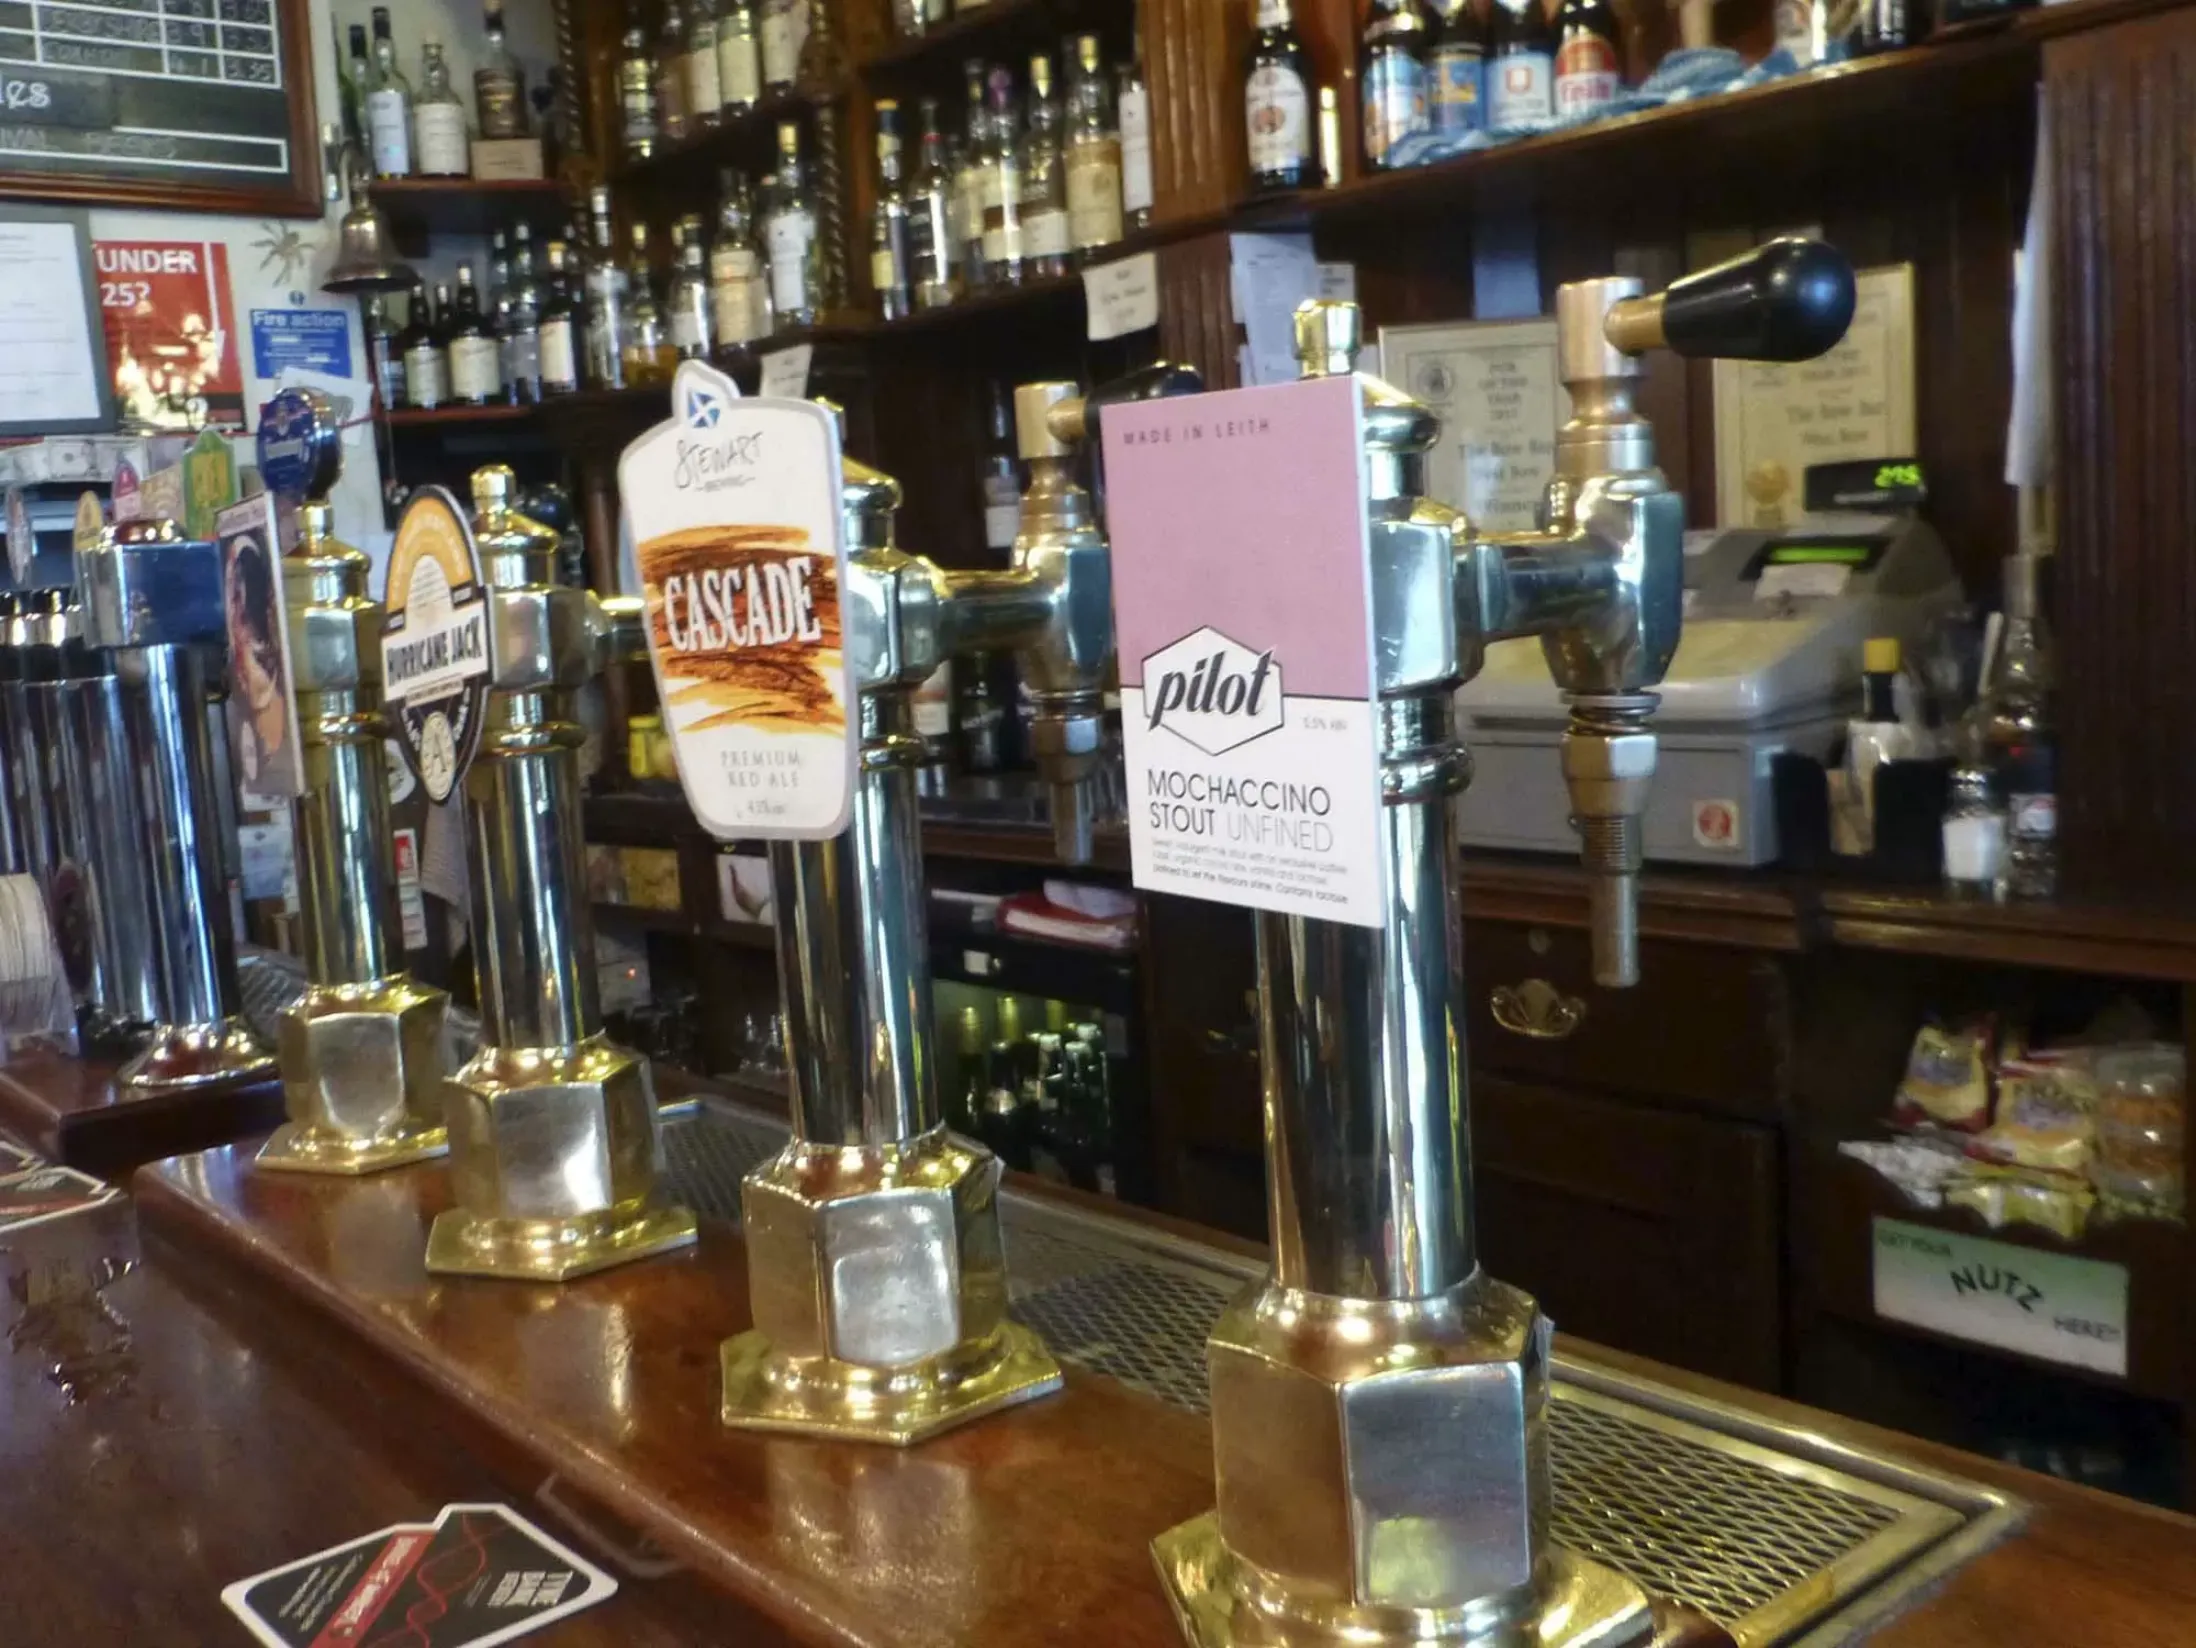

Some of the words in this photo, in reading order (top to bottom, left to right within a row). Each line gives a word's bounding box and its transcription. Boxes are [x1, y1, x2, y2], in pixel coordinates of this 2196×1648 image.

[97, 249, 198, 273] UNDER
[100, 281, 151, 307] 25?
[1123, 427, 1172, 444] MADE
[1183, 424, 1203, 440] IN
[1215, 418, 1269, 440] LEITH
[675, 431, 763, 488] STEWART
[664, 556, 822, 651] CASCADE
[386, 630, 449, 688] HURRICANE
[451, 615, 483, 664] JACK
[1149, 650, 1274, 732] pilot
[720, 748, 801, 768] PREMIUM
[728, 771, 760, 788] RED
[768, 771, 798, 789] ALE
[1147, 768, 1332, 817] MOCHACCINO
[1149, 801, 1217, 836] STOUT
[1227, 811, 1335, 853] UNFINED
[1950, 1262, 2045, 1314] NUTZ
